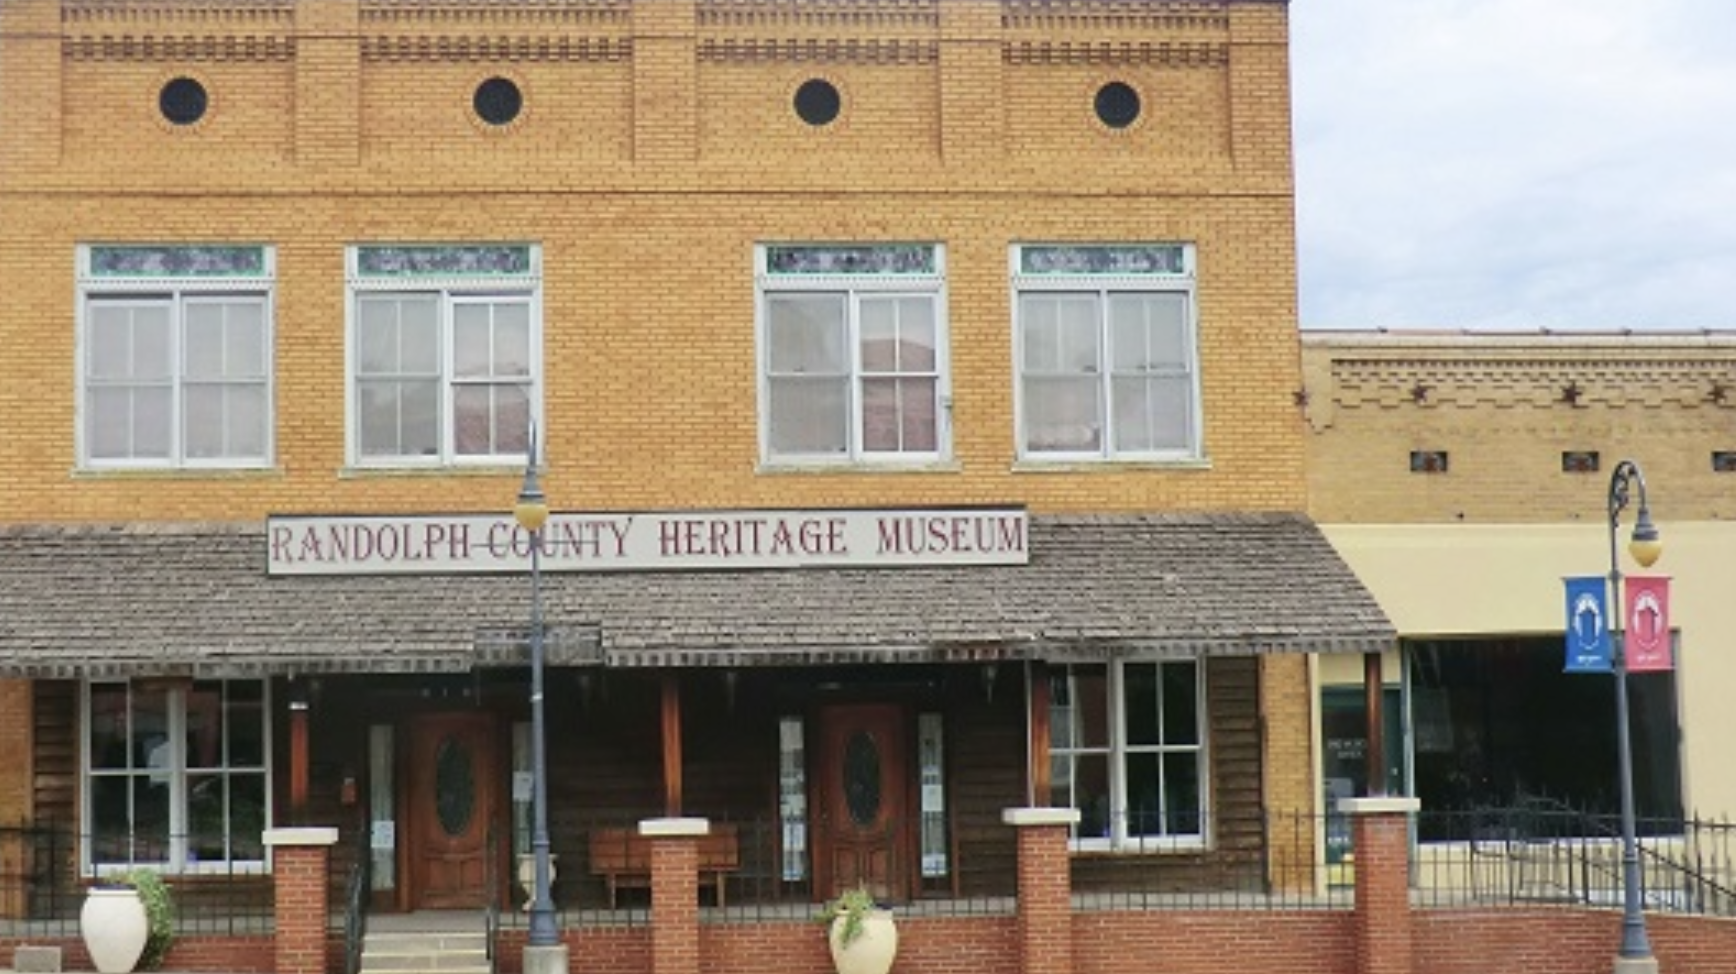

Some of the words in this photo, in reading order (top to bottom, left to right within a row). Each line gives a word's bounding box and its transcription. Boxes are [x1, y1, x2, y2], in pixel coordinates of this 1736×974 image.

[271, 521, 472, 563] RANDOLPH
[487, 517, 633, 561] COUNTY
[659, 517, 848, 557] HERITAGE
[876, 516, 1024, 553] MUSEUM
